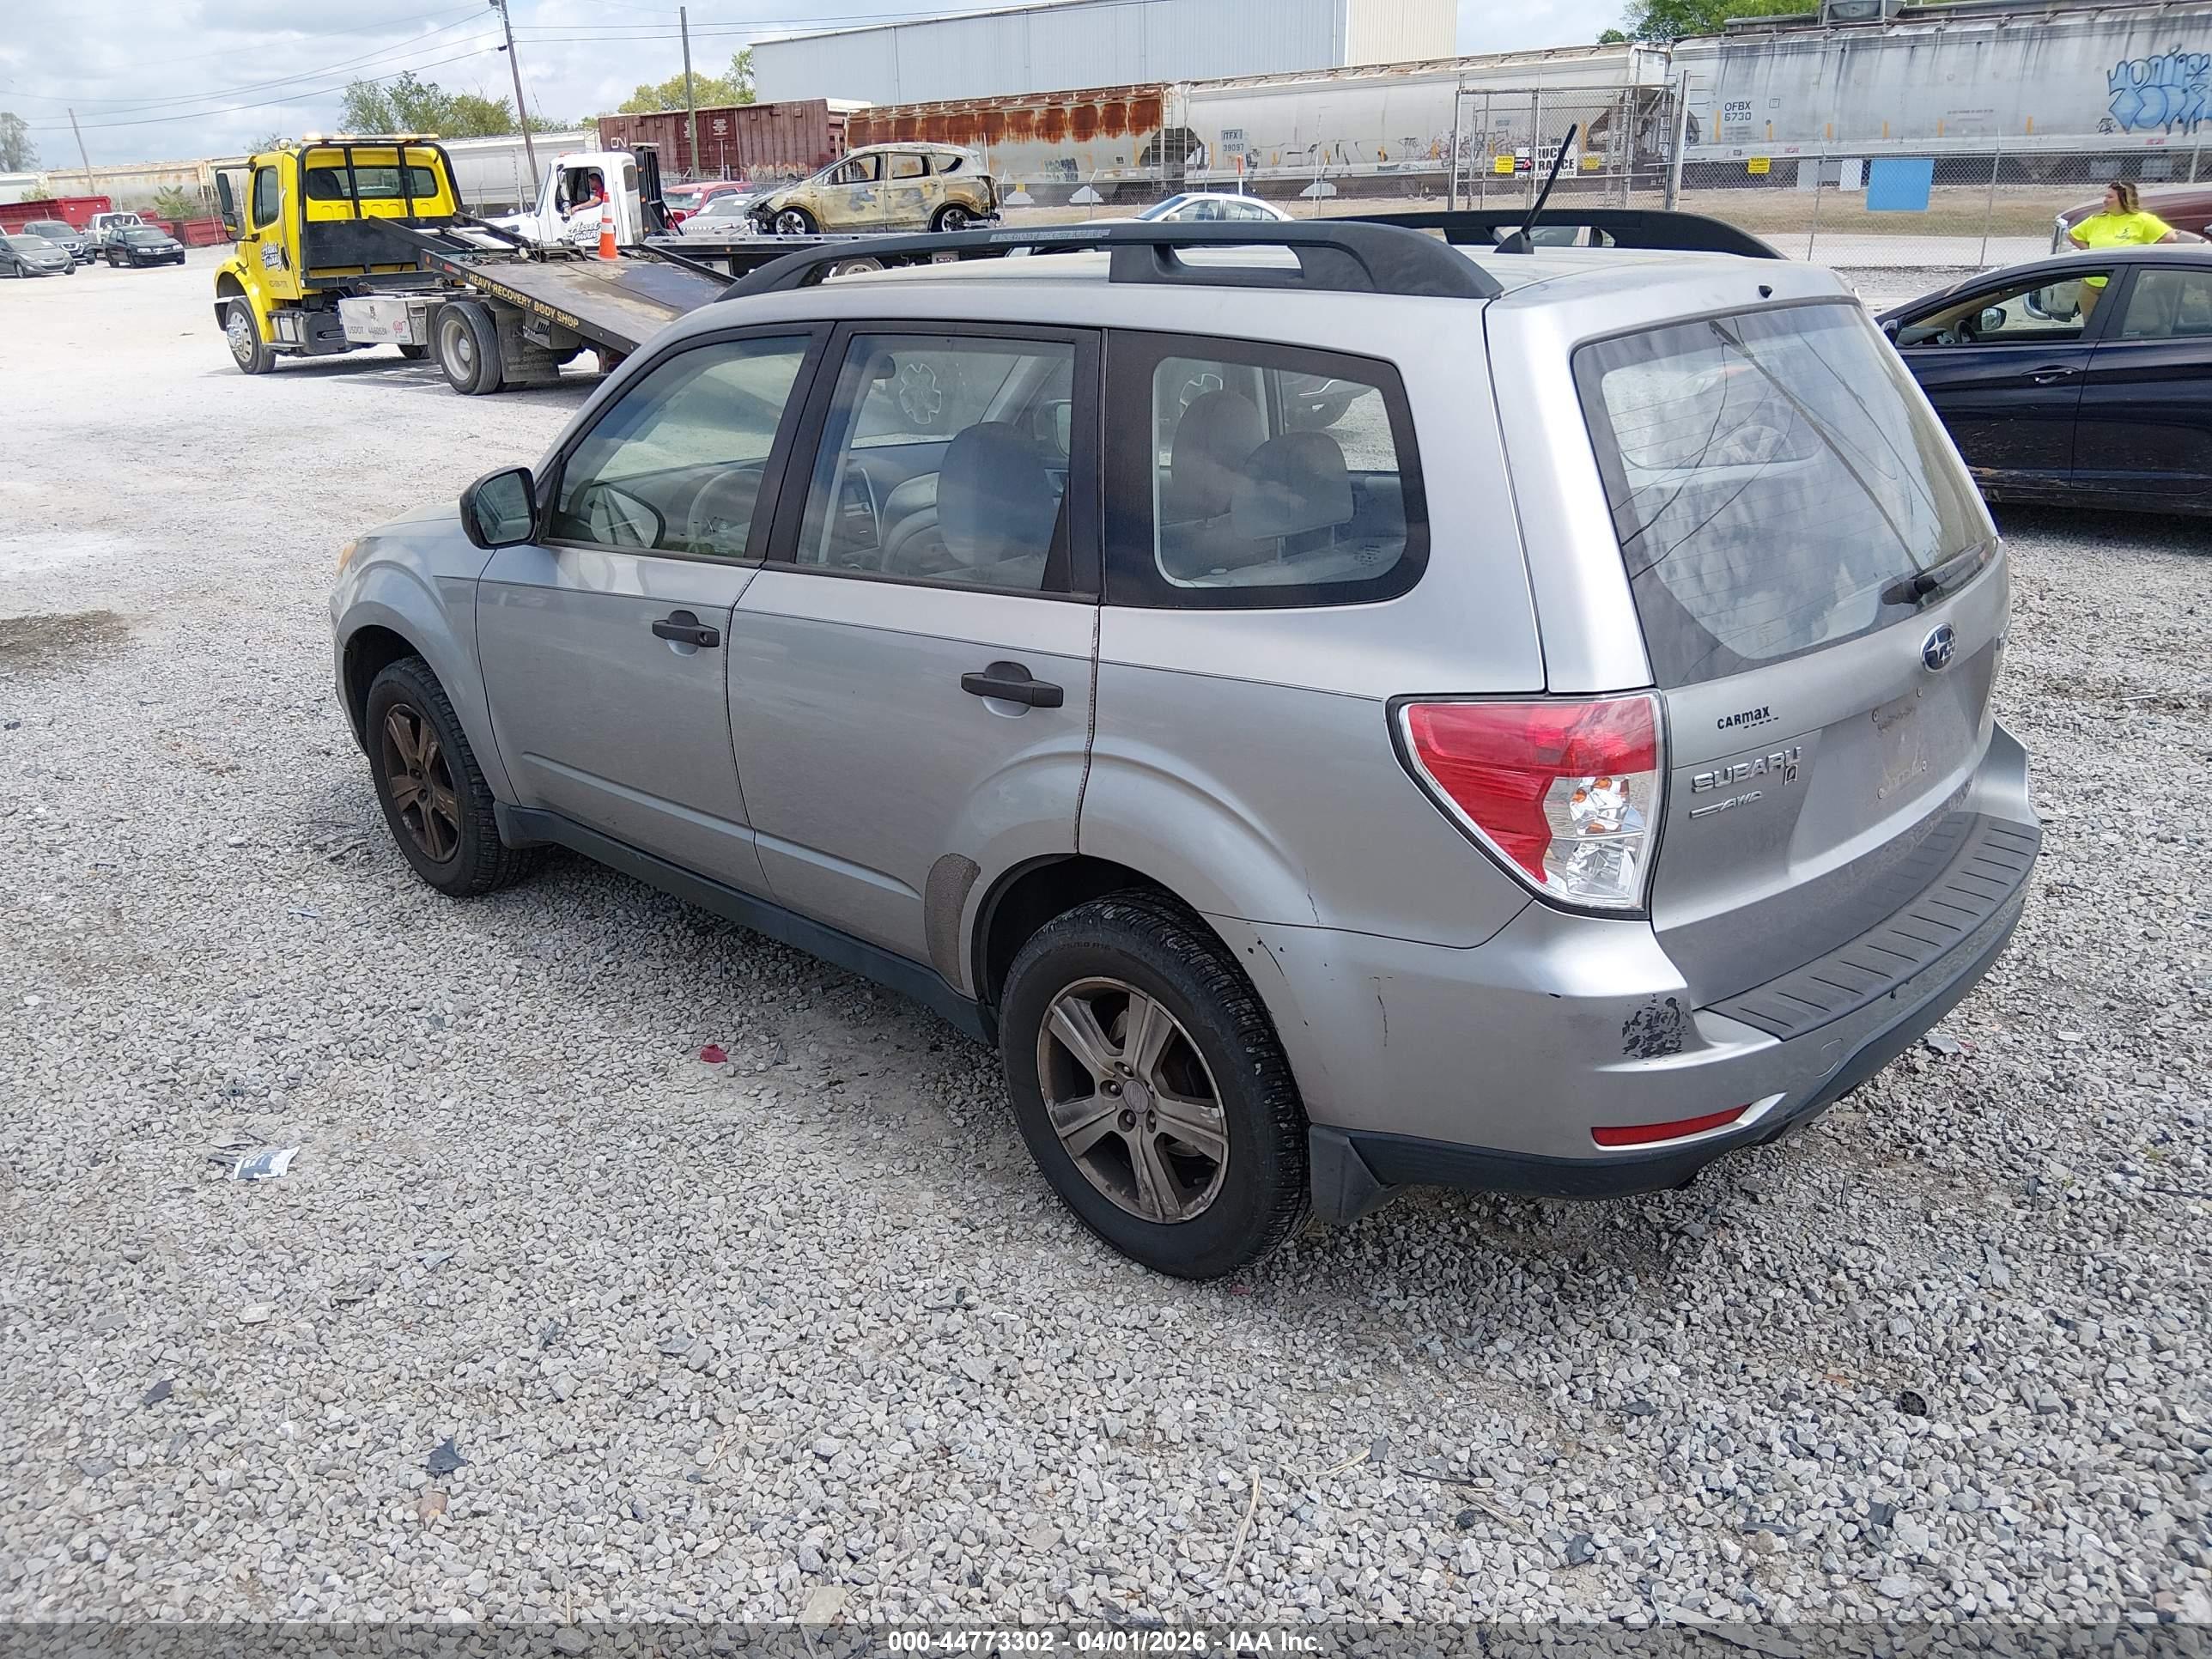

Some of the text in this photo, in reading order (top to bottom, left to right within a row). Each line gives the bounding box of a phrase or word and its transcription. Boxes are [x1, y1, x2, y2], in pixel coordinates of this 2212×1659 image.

[1724, 100, 1752, 112] OFBX
[1724, 112, 1752, 122] 6730
[611, 137, 627, 149] CN
[568, 221, 601, 233] Asset
[469, 272, 579, 329] HEAVY RECOVERY BODY SHOP
[1691, 746, 1802, 794] SUBARU
